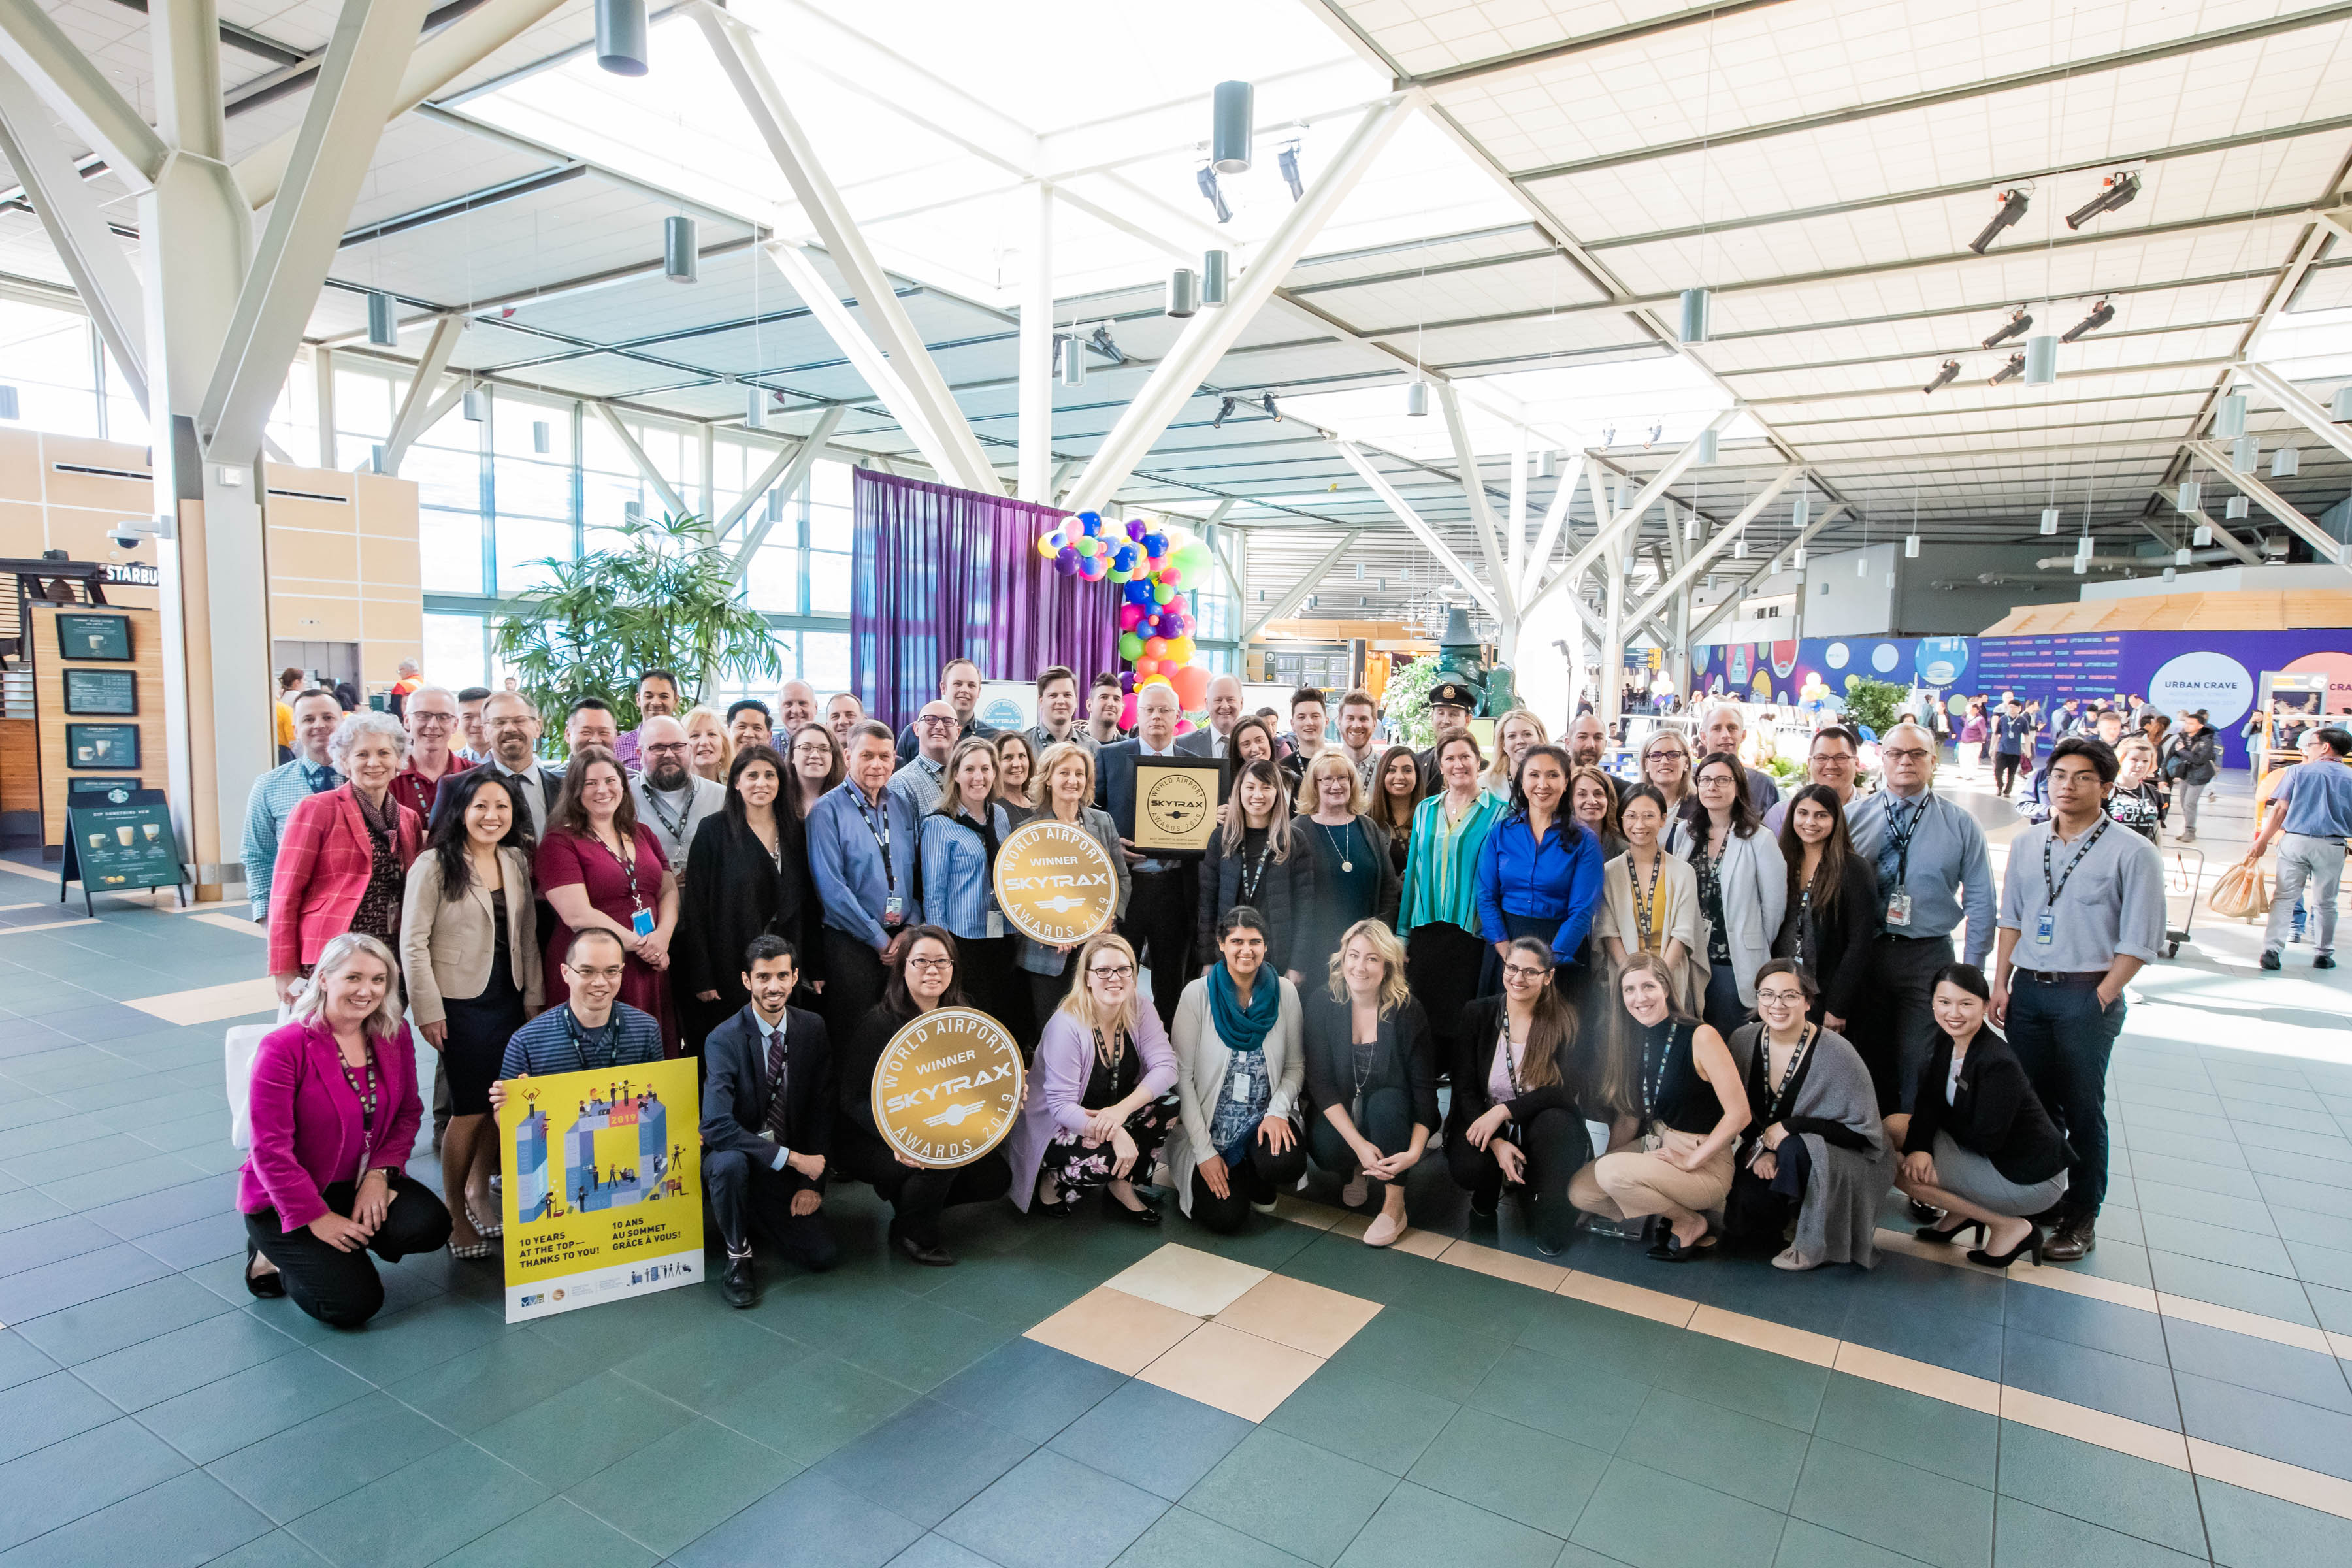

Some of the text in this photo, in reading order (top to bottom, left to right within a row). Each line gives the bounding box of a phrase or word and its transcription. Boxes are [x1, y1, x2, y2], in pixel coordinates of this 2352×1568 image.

[1152, 777, 1203, 797] WORLD AIRPORT
[1152, 812, 1201, 832] AWARDS 2019
[1003, 828, 1103, 872] WORLD AIRPORT
[1030, 856, 1078, 866] WINNER
[1005, 872, 1108, 890] SKYTRAX
[1011, 897, 1109, 938] AWARDS 2019
[883, 1018, 1007, 1088] WORLD AIRPORT
[915, 1049, 976, 1075] WINNER
[886, 1062, 1013, 1114] SKYTRAX
[611, 1114, 636, 1124] 2019
[894, 1094, 1013, 1158] AWARDS 2019
[612, 1217, 644, 1230] 10 ANS
[612, 1224, 666, 1240] AU SOMMET
[520, 1232, 565, 1247] 10 YEARS
[612, 1231, 681, 1250] GRÂCE À VOUS!
[519, 1248, 532, 1258] AT
[534, 1244, 553, 1255] THE
[519, 1247, 600, 1269] THANKS TO YOU!
